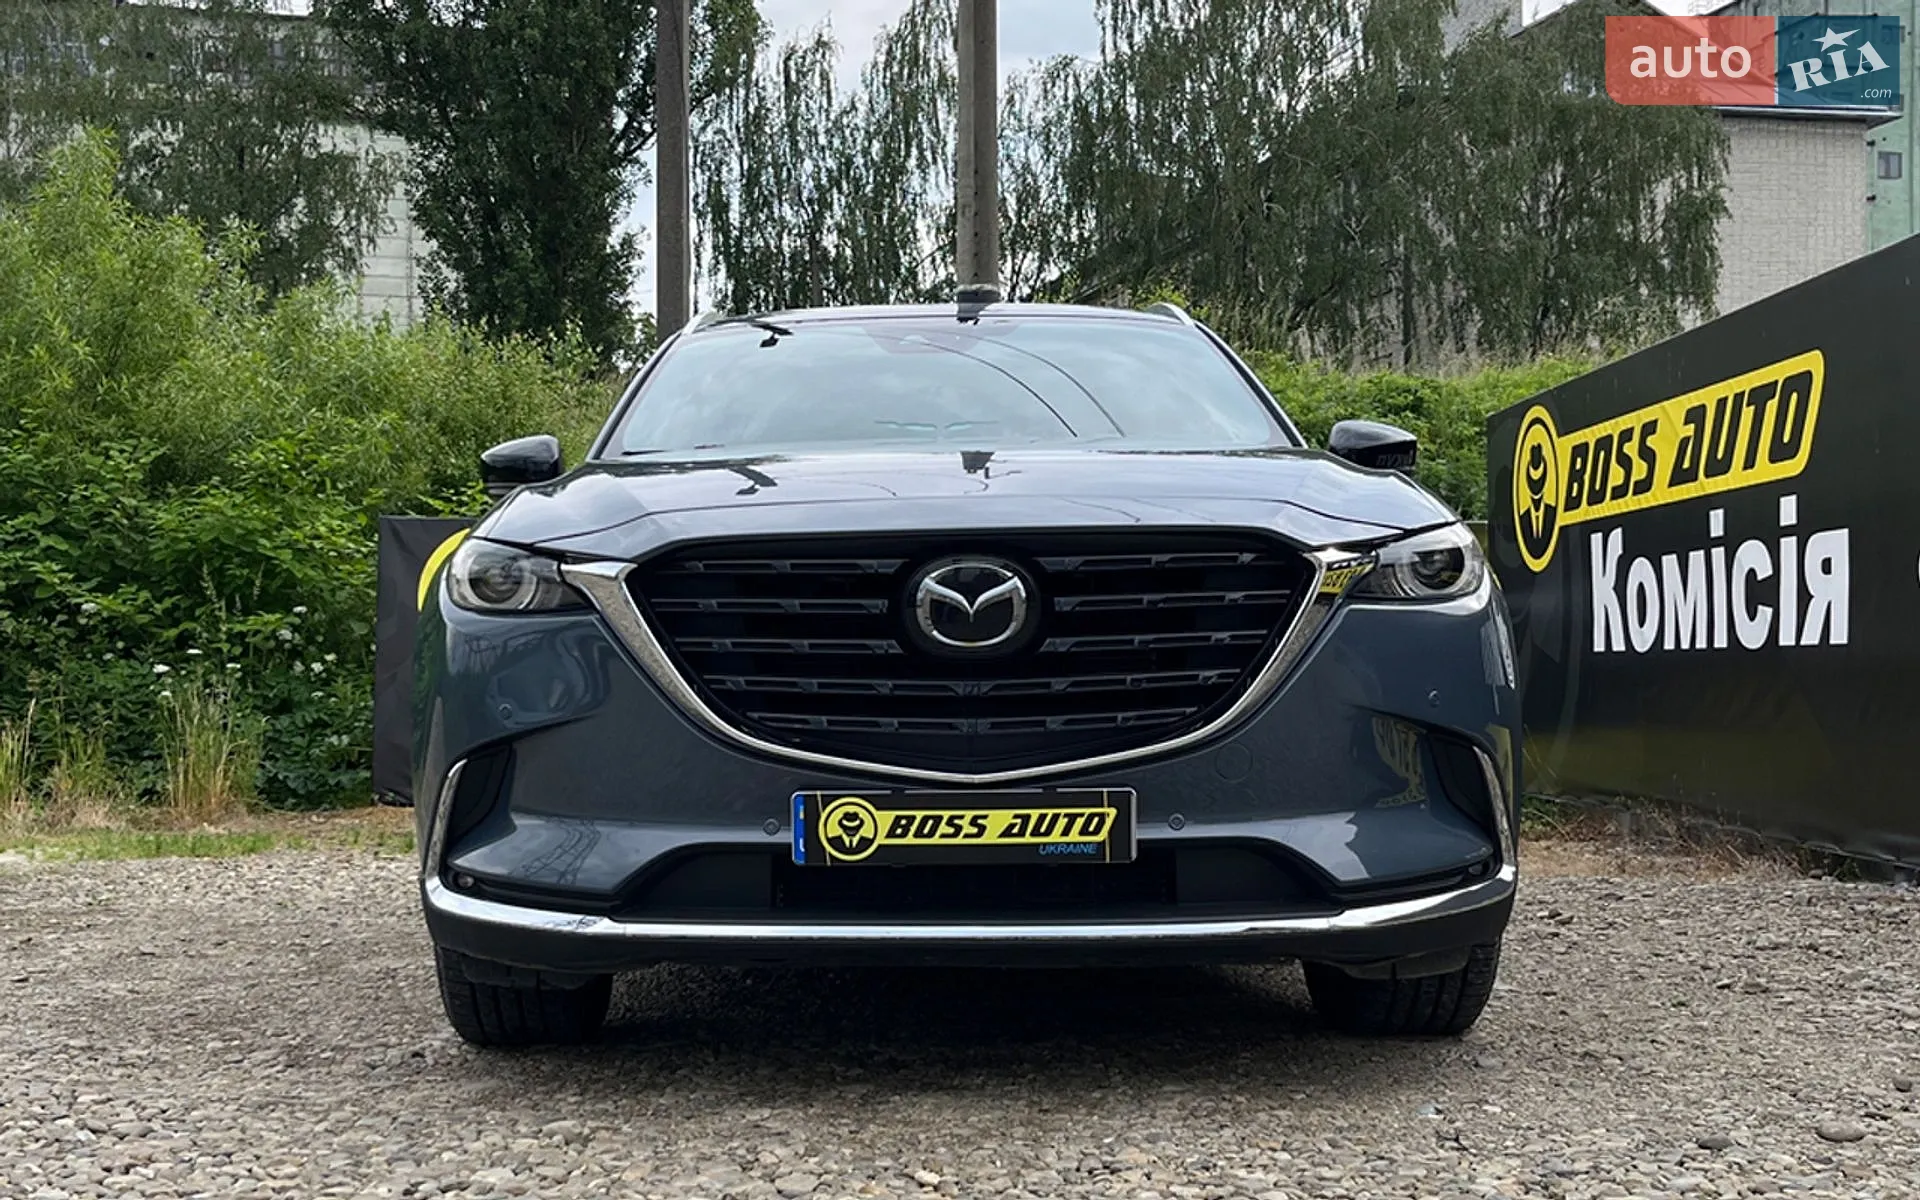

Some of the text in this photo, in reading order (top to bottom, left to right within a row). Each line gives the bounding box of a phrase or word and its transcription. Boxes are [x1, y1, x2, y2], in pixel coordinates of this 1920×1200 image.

[1563, 368, 1815, 513] BOSS AUTO
[1589, 493, 1850, 654] Комісія
[884, 811, 1110, 839] BOSS AUTO
[1039, 842, 1098, 856] UKRAINE
